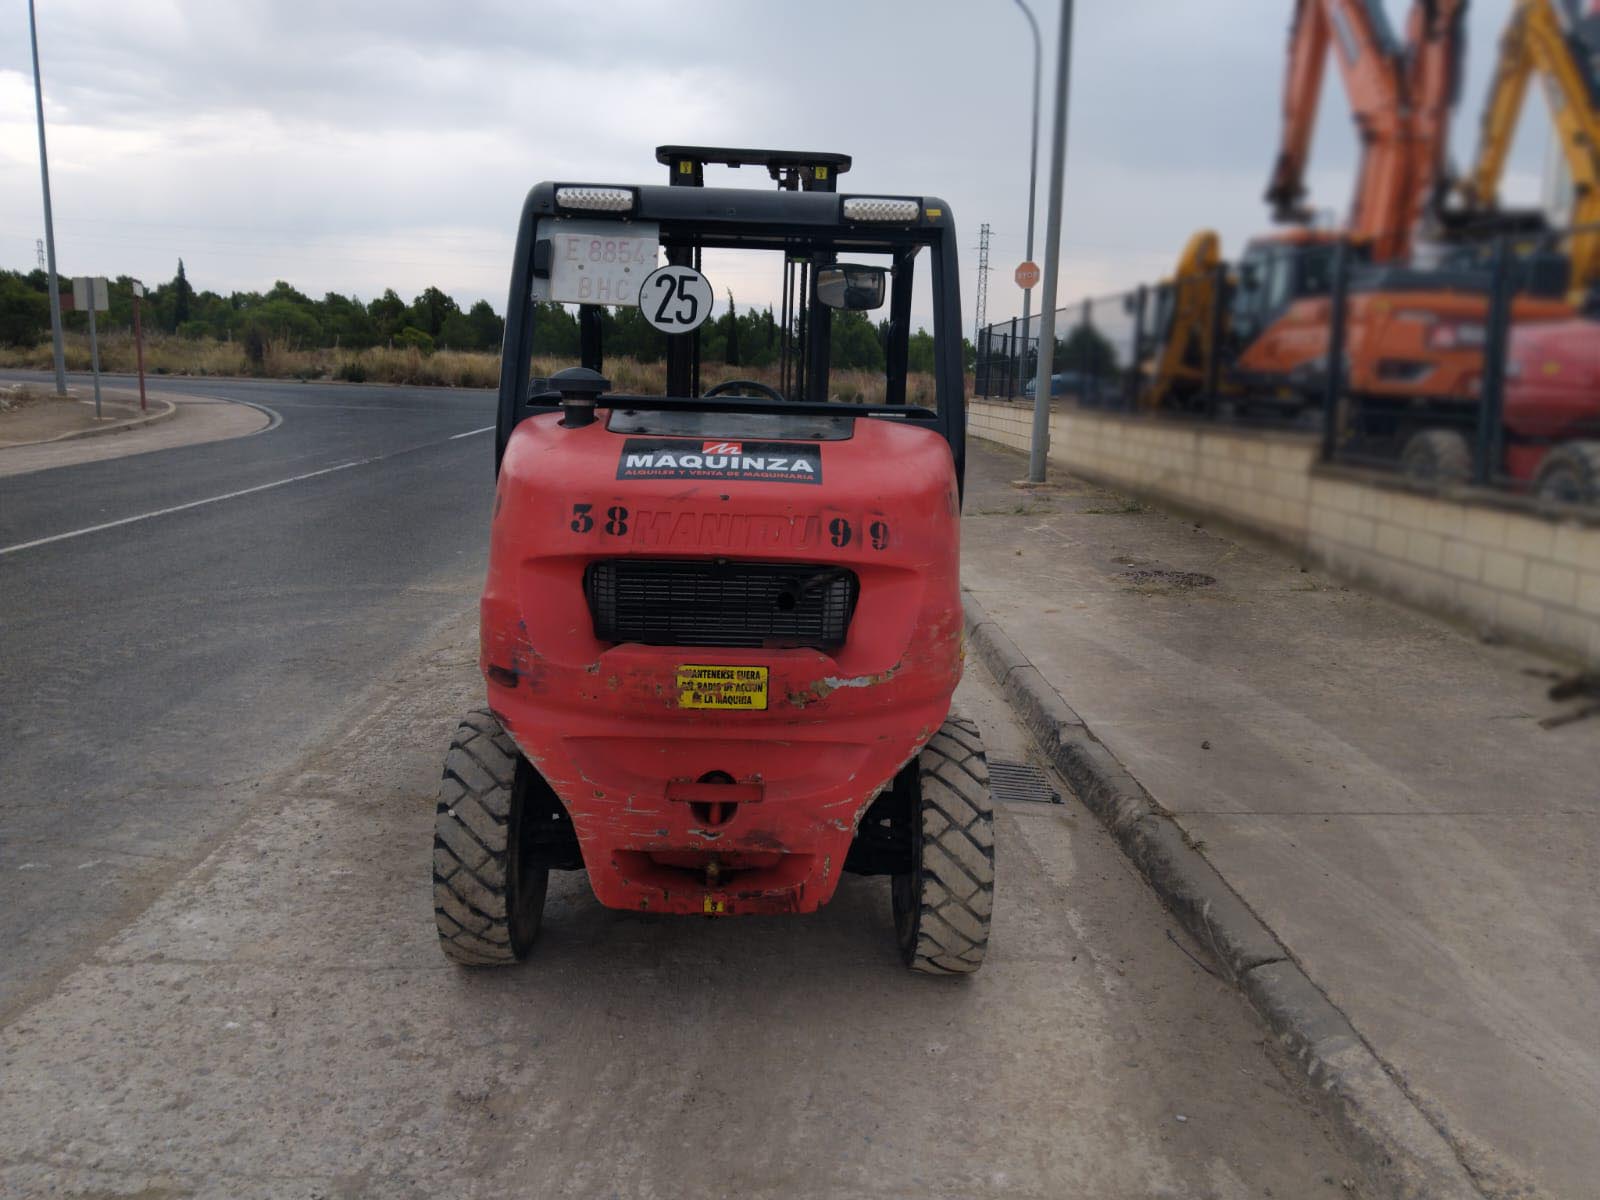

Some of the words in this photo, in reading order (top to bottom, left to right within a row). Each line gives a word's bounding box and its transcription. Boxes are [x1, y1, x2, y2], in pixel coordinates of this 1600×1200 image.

[654, 273, 698, 325] 25
[625, 454, 815, 473] MAQUINZA
[743, 472, 814, 481] MAQUINARIA
[704, 694, 713, 704] LA
